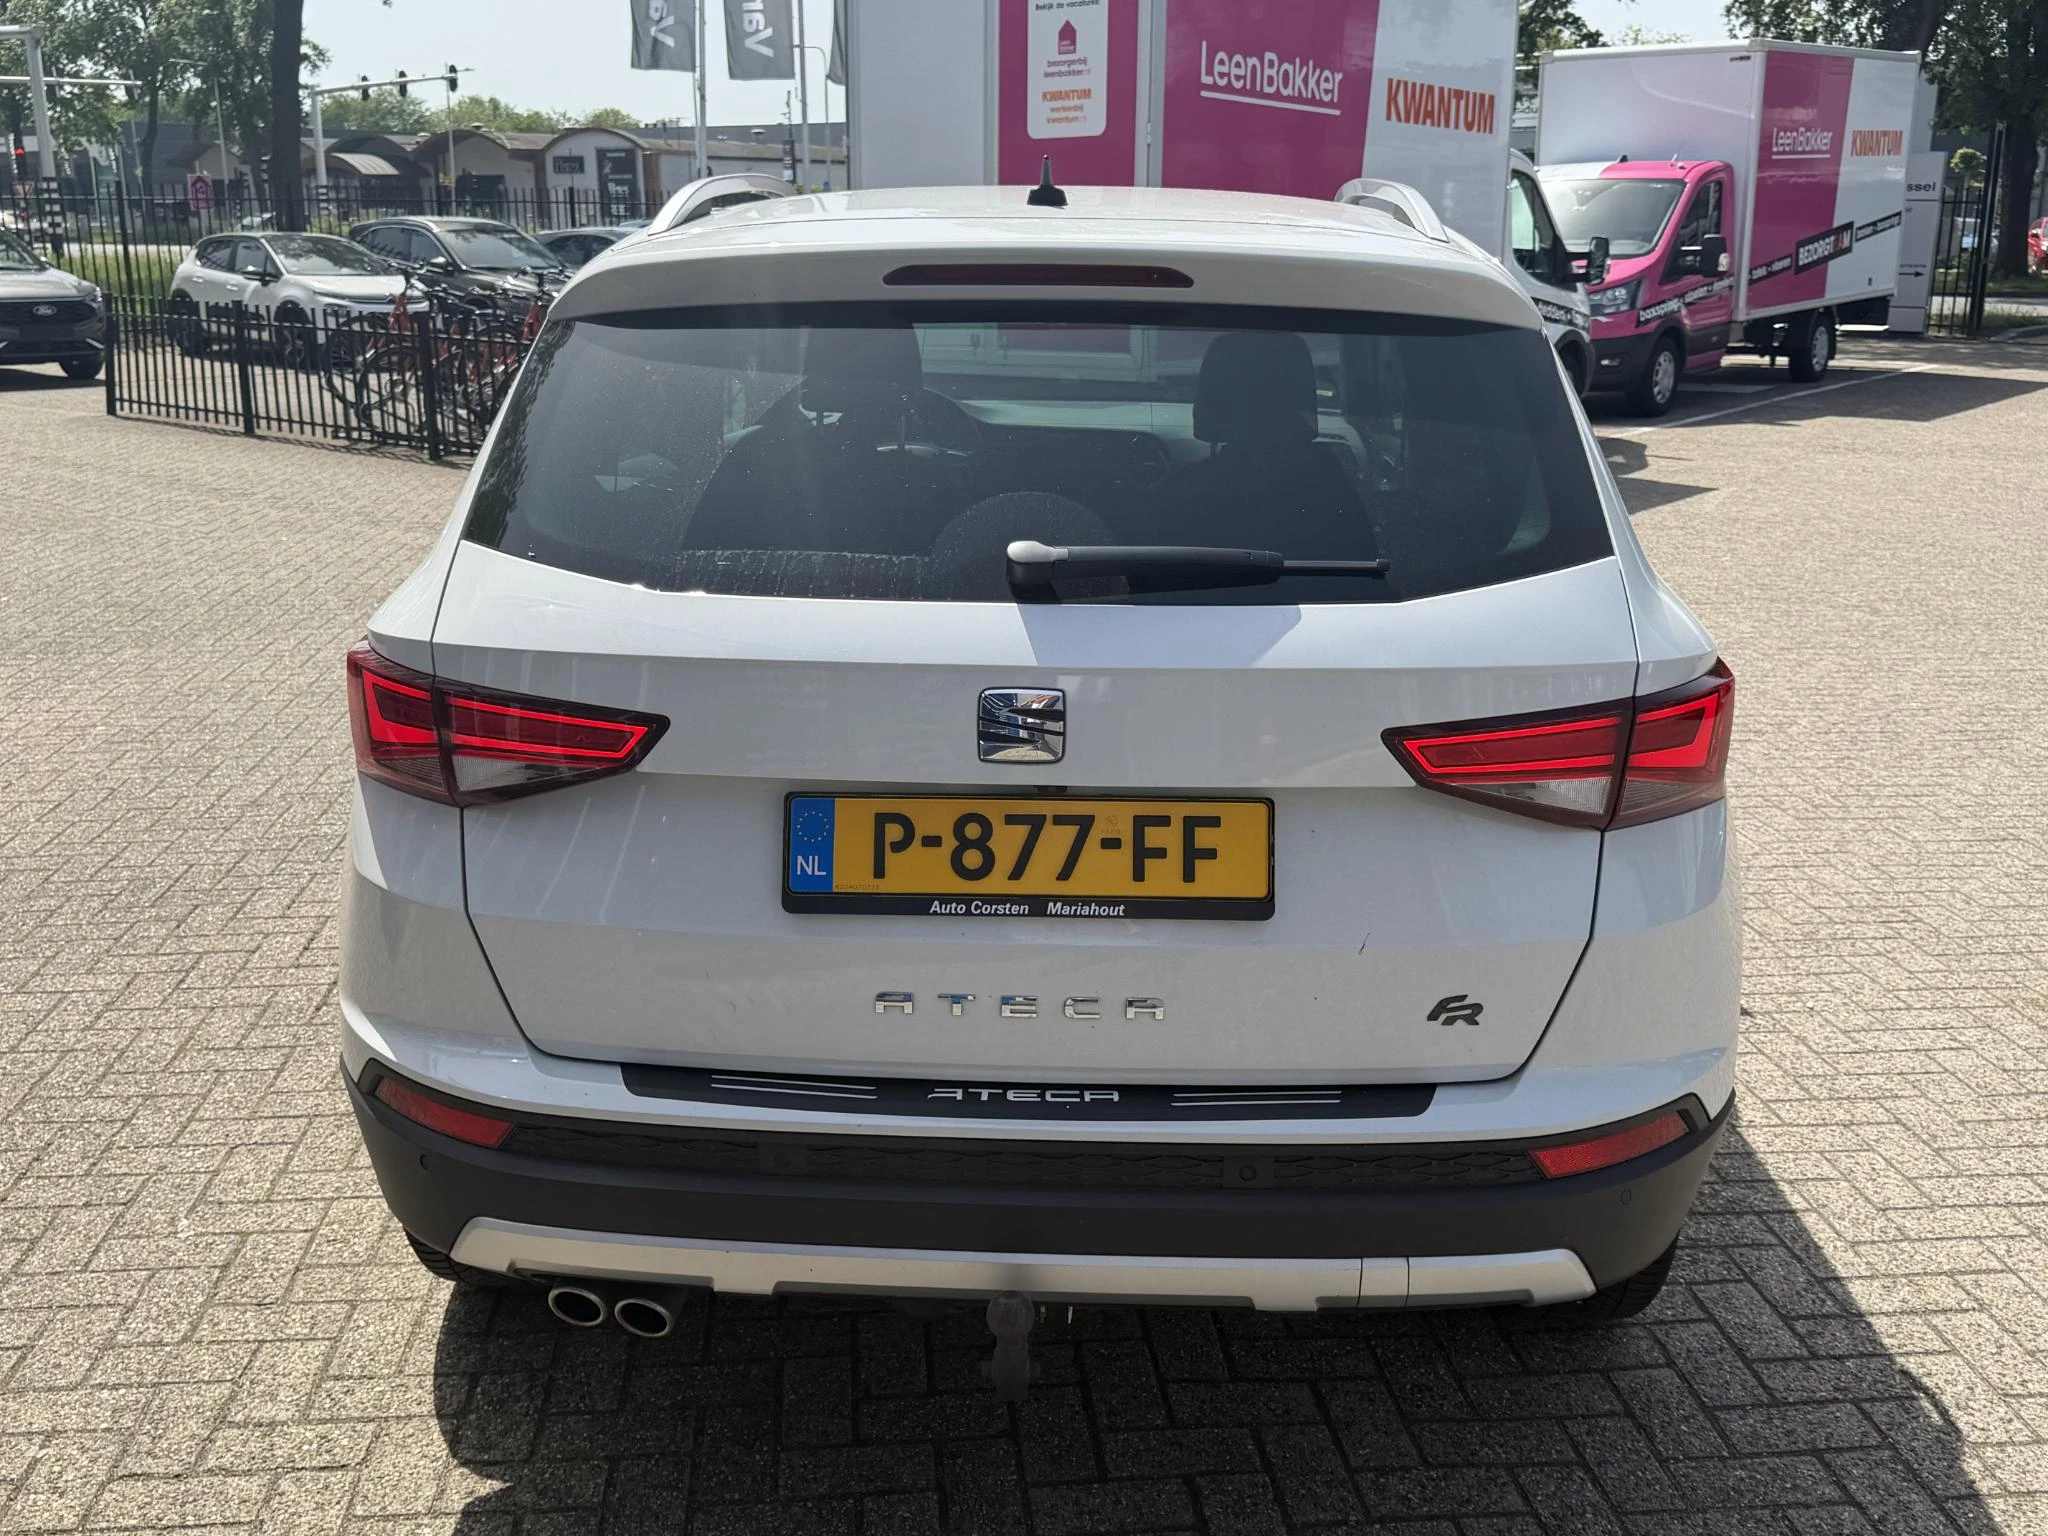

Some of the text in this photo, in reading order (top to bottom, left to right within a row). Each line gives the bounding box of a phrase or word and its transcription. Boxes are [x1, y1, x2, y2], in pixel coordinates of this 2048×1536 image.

[1200, 40, 1343, 103] LeenBakker
[1042, 88, 1092, 102] KWANTUM
[1385, 77, 1495, 134] KWANTUM
[1772, 127, 1833, 152] LeenBakker
[1851, 130, 1903, 157] KWANTUM
[873, 812, 1221, 883] P-877-FF
[797, 855, 826, 876] NL
[929, 900, 1125, 917] Auto Corsten Mariahout
[875, 991, 1164, 1020] ATECA
[928, 1088, 1119, 1103] ATECA
